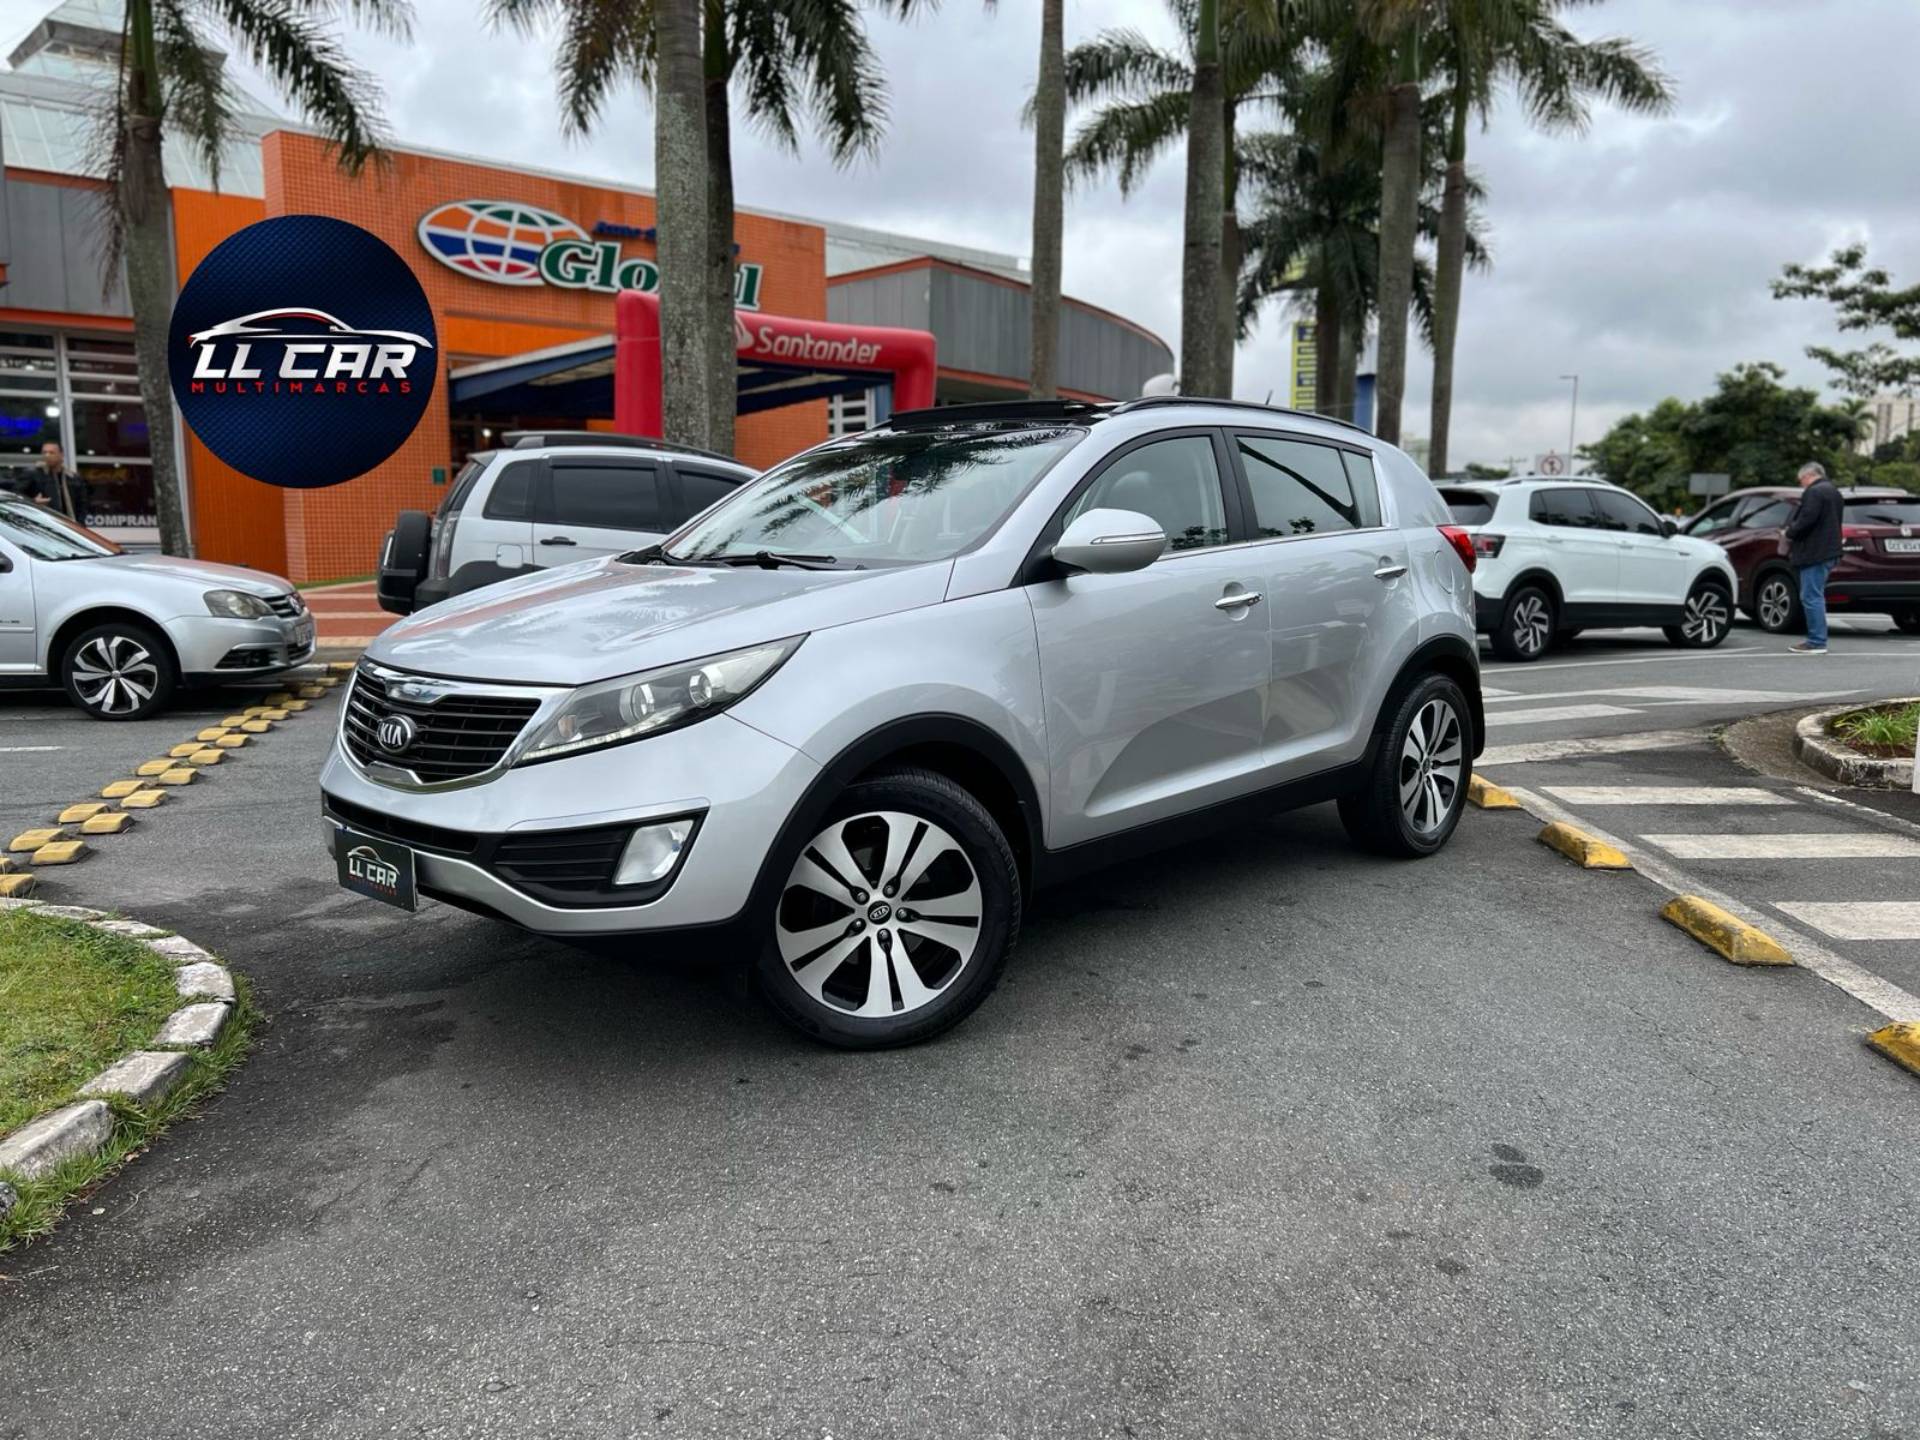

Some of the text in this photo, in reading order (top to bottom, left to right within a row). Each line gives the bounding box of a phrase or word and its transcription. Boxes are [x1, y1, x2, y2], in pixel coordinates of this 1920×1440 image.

[540, 241, 762, 310] Glol
[757, 326, 882, 364] Santander
[380, 722, 402, 746] KIA
[349, 857, 364, 878] LL
[366, 863, 397, 889] CAR
